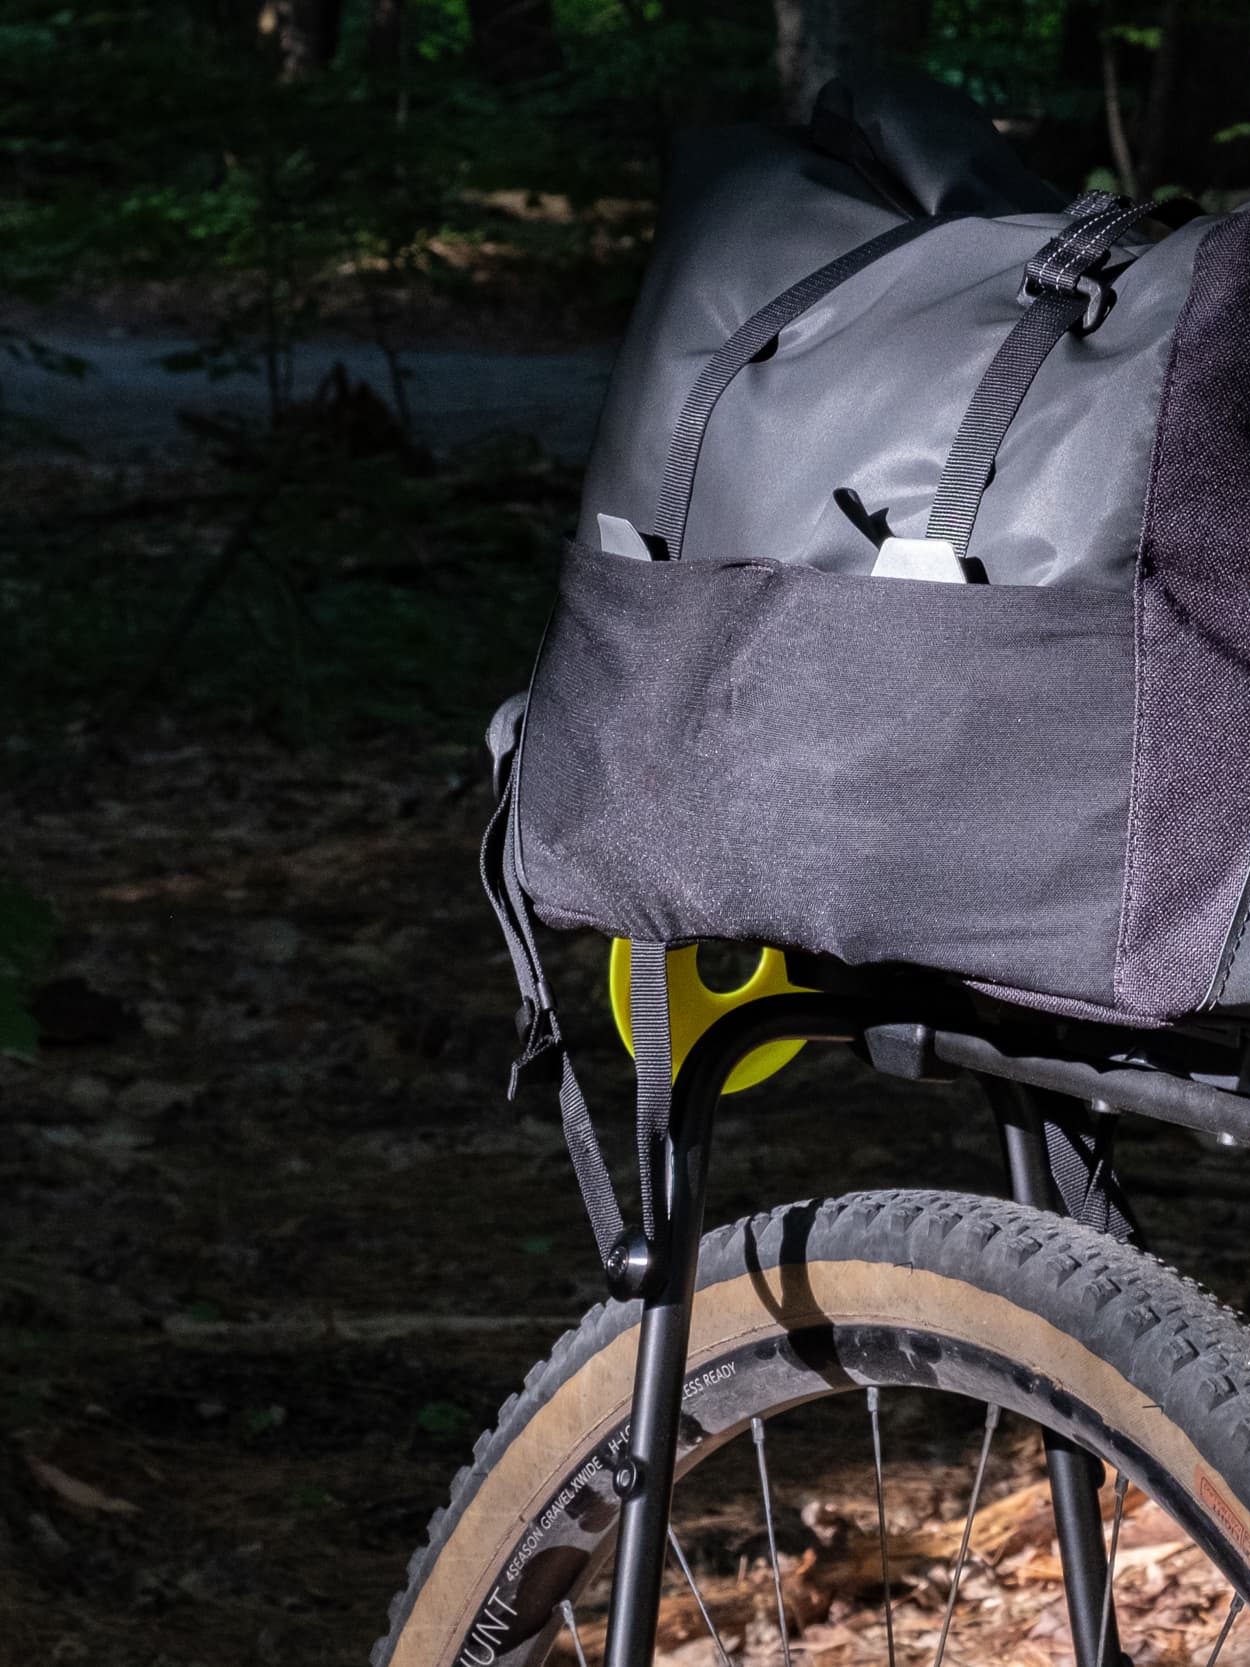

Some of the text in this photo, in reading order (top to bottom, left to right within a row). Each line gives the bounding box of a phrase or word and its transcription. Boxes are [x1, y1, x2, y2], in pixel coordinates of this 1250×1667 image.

[682, 1361, 737, 1401] ESS READY
[505, 1526, 544, 1584] 4SEASON
[540, 1486, 576, 1531] GRAVEL
[572, 1455, 604, 1495] XWIDE
